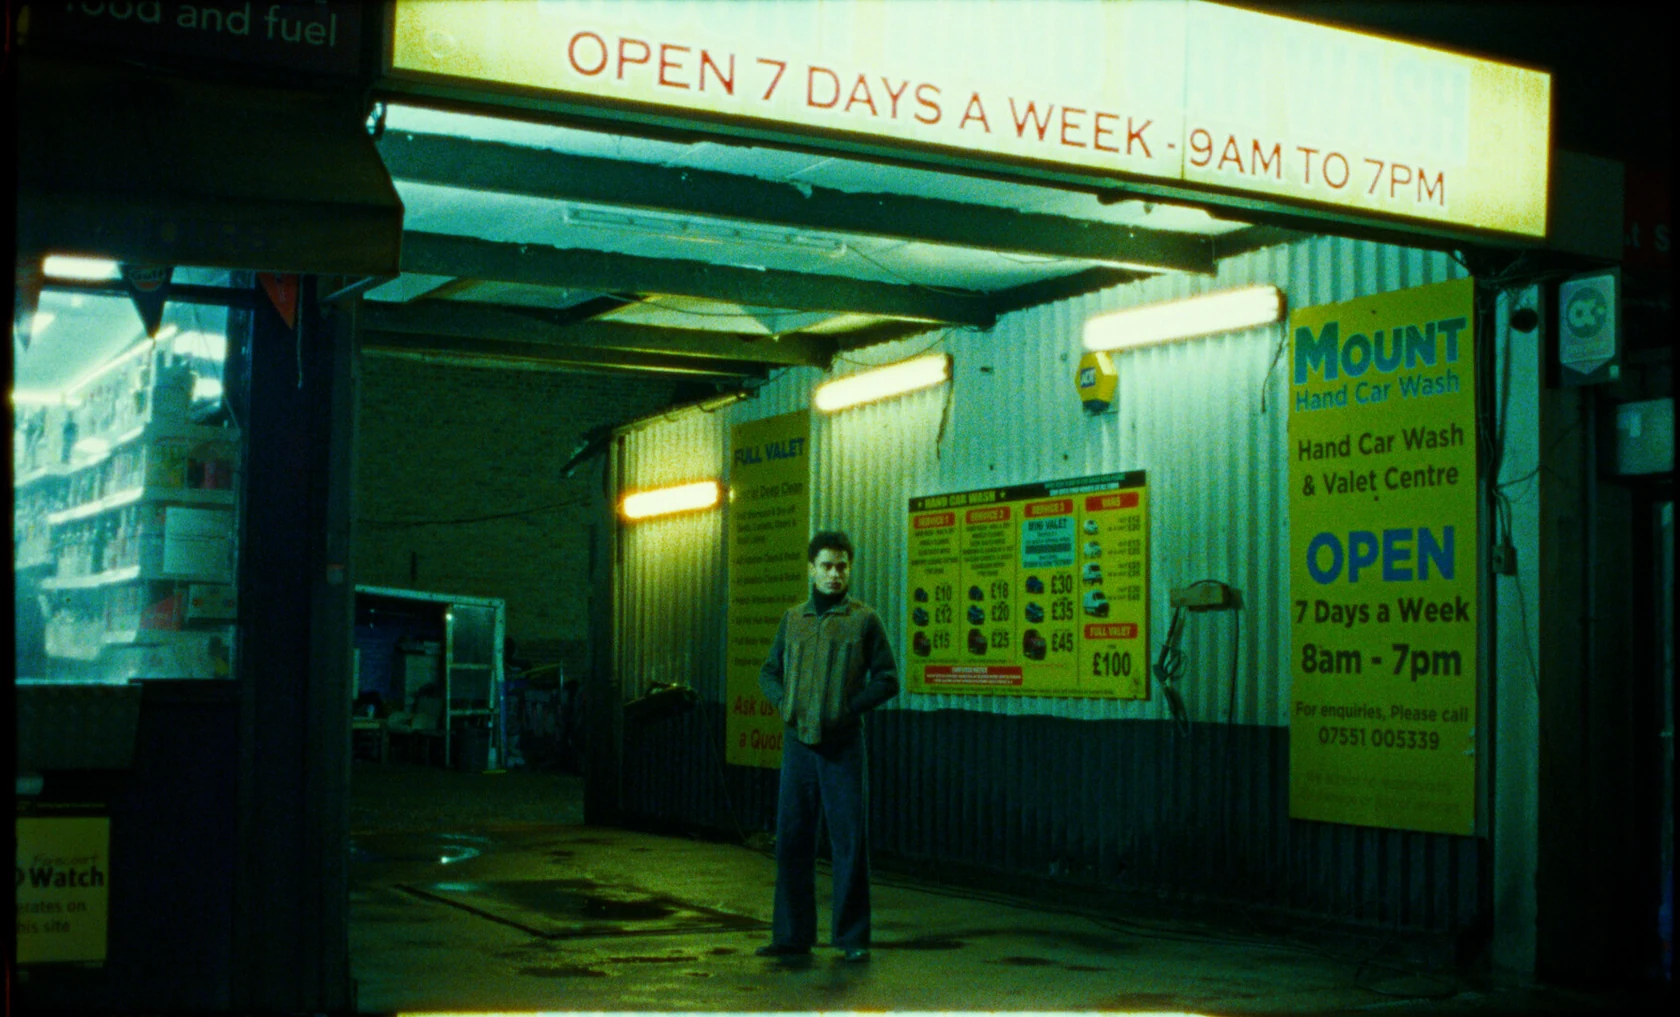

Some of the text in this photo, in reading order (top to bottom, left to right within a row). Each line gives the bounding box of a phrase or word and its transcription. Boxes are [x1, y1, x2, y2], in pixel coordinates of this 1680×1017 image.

[177, 1, 251, 35] and
[262, 5, 338, 47] fuel
[569, 30, 735, 96] OPEN
[756, 57, 786, 101] 7
[807, 65, 942, 125] DAYS
[960, 91, 991, 134] A
[1009, 96, 1152, 158] WEEK
[1190, 129, 1281, 179] 9AM
[1296, 146, 1350, 197] TO
[1362, 167, 1444, 206] 7PM
[1295, 317, 1466, 385] MOUNT
[1296, 368, 1460, 412] Hand Car Wash
[734, 437, 805, 466] FULL VALET
[1298, 423, 1464, 461] Hand Car Wash
[1302, 465, 1458, 496] & Valet Centre
[968, 490, 996, 503] WASH
[1045, 517, 1068, 530] VALET
[1306, 524, 1455, 585] OPEN
[935, 584, 952, 602] £10
[1051, 574, 1073, 595] £30
[935, 606, 952, 624] £12
[1051, 601, 1074, 622] £35
[1295, 596, 1470, 628] 7 Days a Week
[933, 630, 950, 649] £15
[991, 631, 1010, 649] £25
[1051, 633, 1074, 653] £45
[1092, 651, 1132, 677] £100
[1301, 643, 1463, 682] 8am - 7pm
[734, 695, 773, 717] Ask us
[1295, 701, 1469, 723] For enquiries, Please call
[740, 731, 747, 749] a
[1318, 726, 1440, 750] 07551 005339
[29, 865, 104, 888] Watch
[67, 901, 88, 913] on
[44, 919, 71, 933] site
